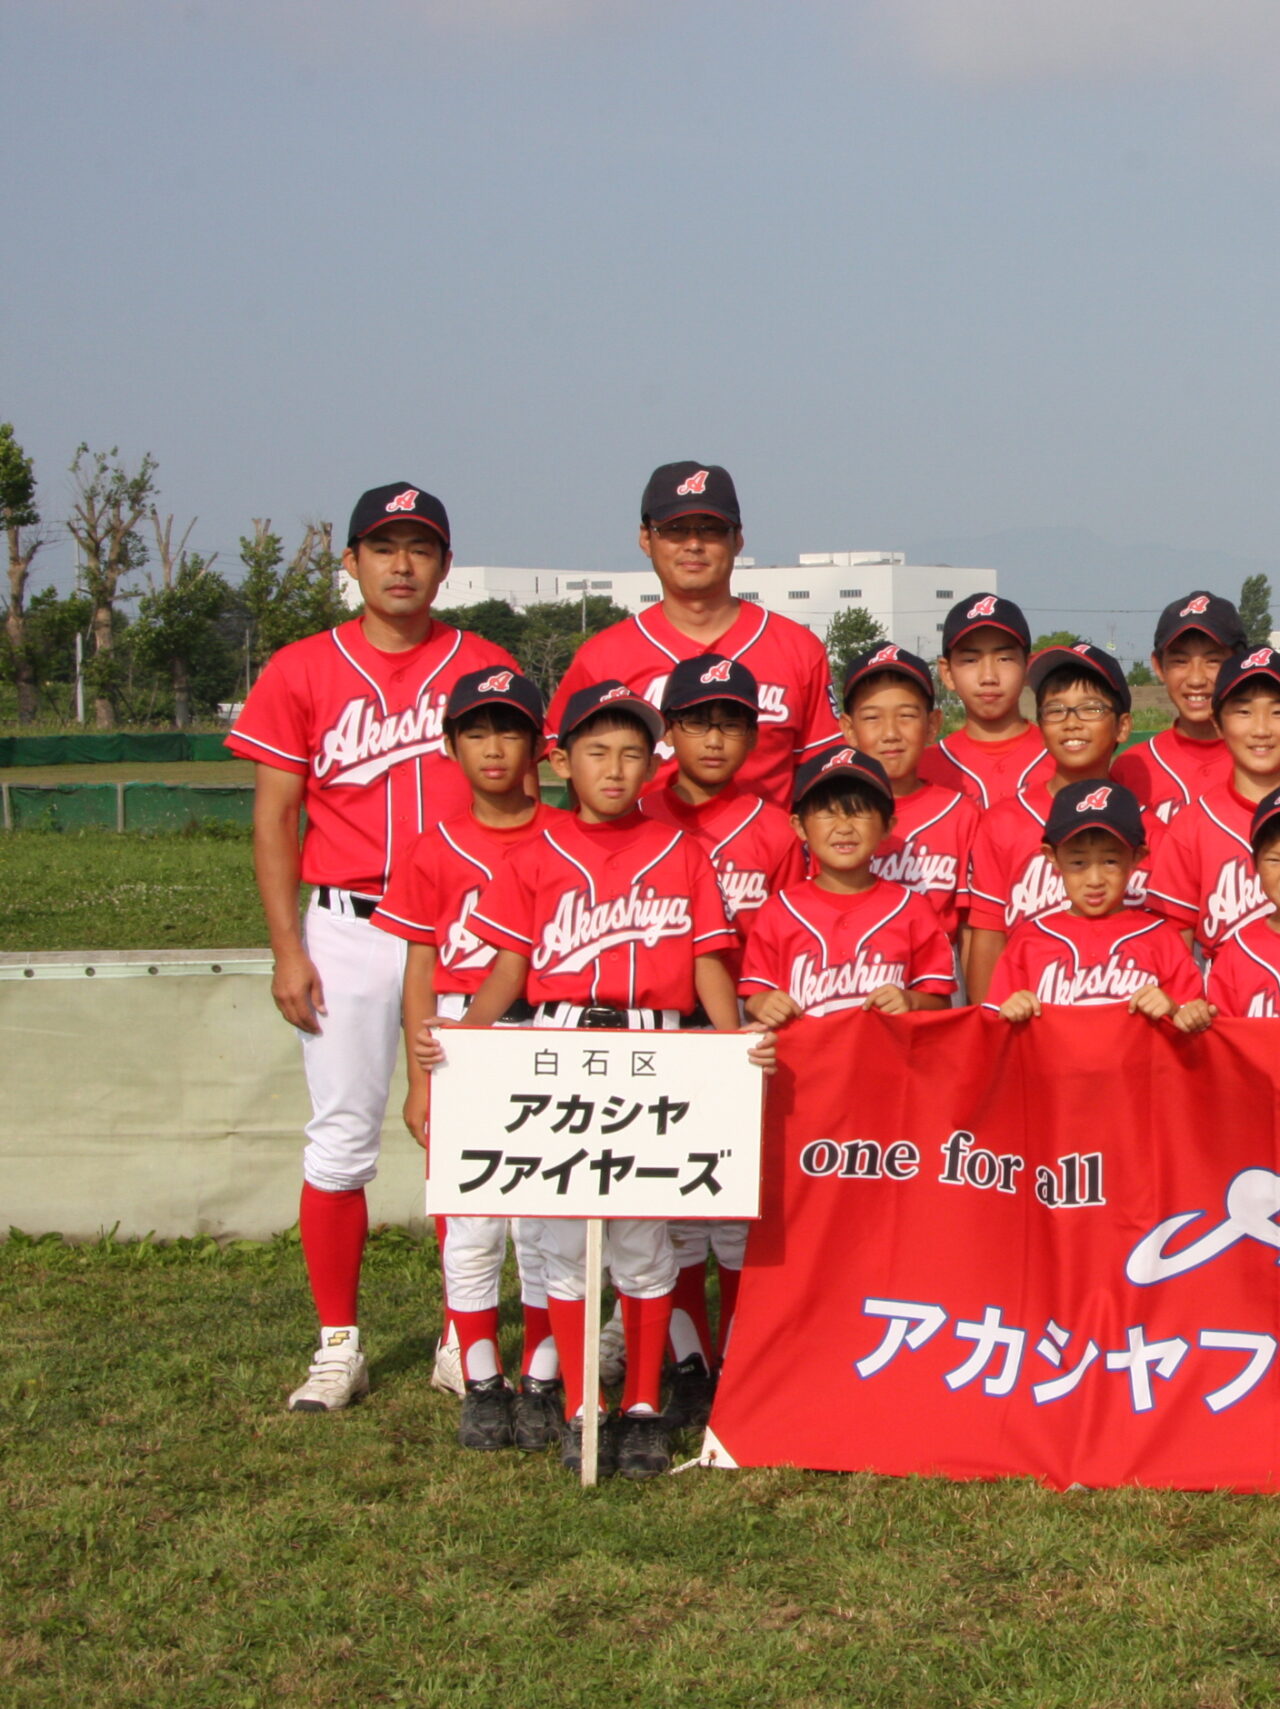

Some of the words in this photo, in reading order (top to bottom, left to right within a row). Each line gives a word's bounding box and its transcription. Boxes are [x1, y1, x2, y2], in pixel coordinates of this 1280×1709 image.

[676, 470, 709, 496] A
[385, 489, 420, 513] A
[967, 596, 998, 619] A
[1179, 596, 1210, 617] A
[1241, 648, 1273, 669] A
[477, 671, 514, 693] A
[700, 660, 732, 684] A
[1076, 787, 1112, 812] A
[532, 883, 692, 970] Akashiya
[534, 1048, 657, 1076] 白石区
[504, 1094, 690, 1135] アカシヤ
[458, 1148, 733, 1197] ファイヤーズ
[800, 1138, 919, 1179] one
[939, 1130, 1024, 1193] for
[1035, 1152, 1106, 1208] all
